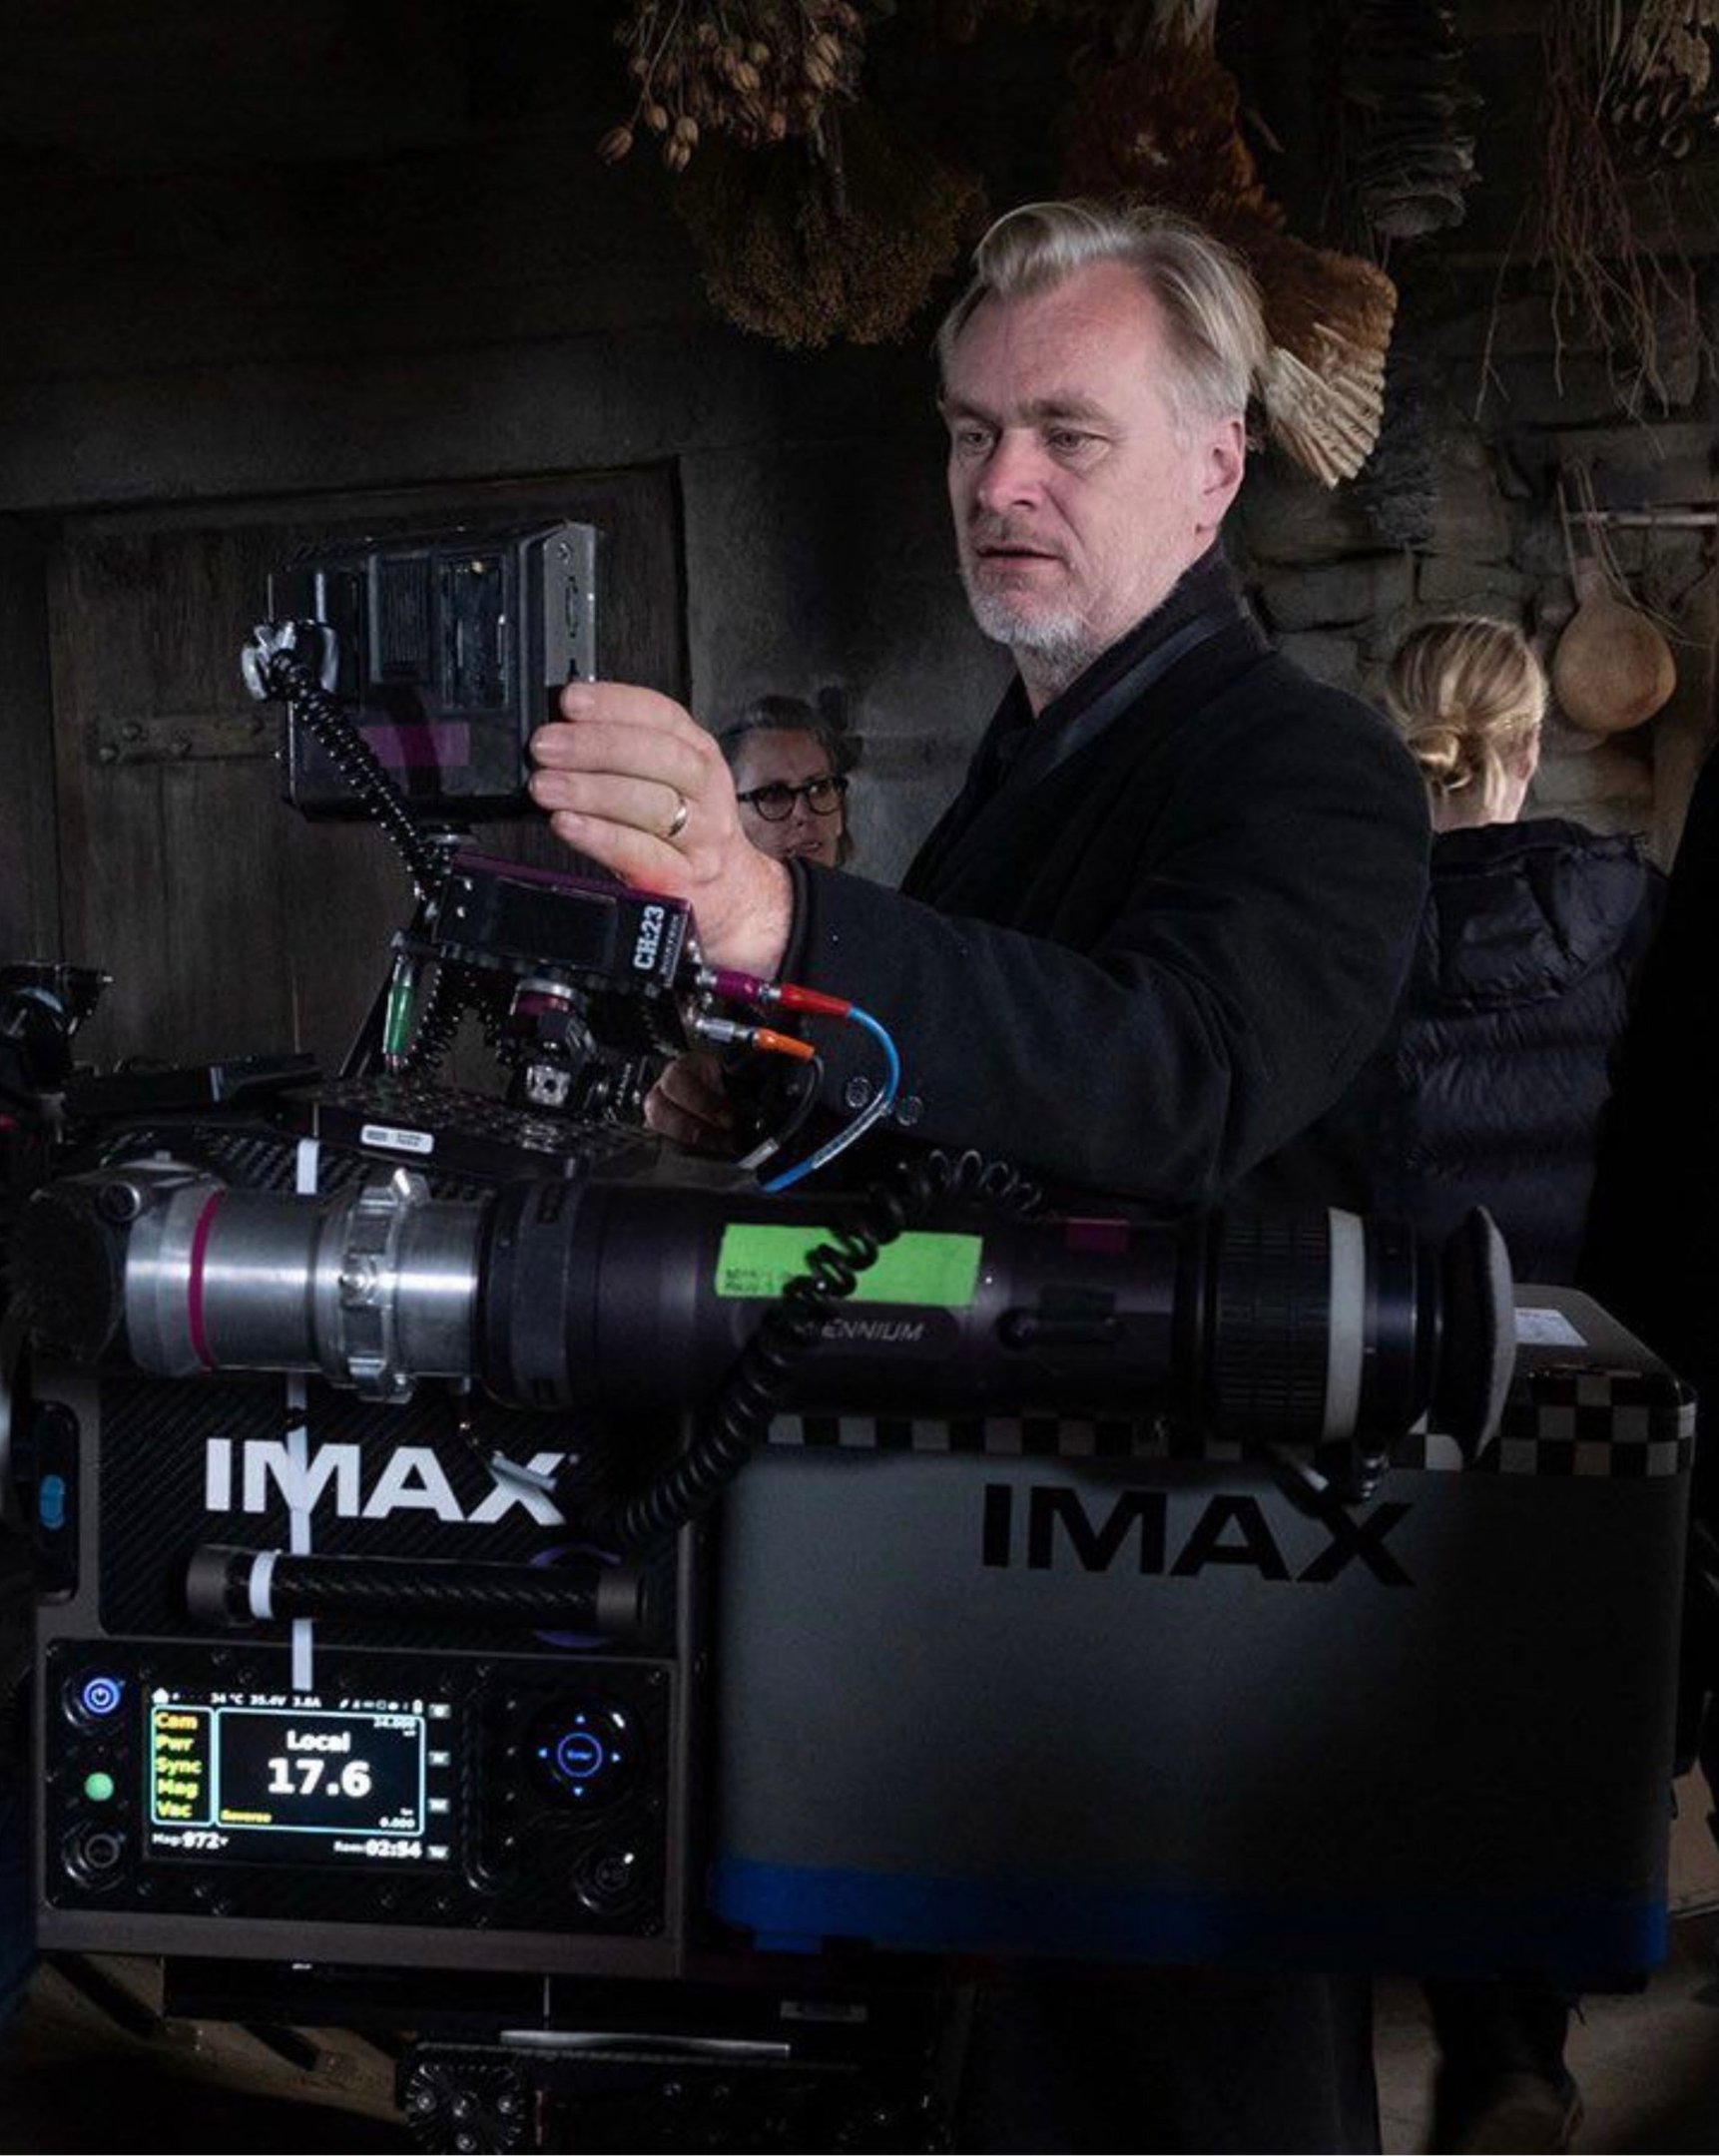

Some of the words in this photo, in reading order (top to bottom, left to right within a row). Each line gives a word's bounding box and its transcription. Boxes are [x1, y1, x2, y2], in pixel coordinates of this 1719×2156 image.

[206, 1438, 566, 1526] IMAX
[983, 1484, 1416, 1587] IMAX
[155, 1712, 199, 1730] Cam
[156, 1735, 195, 1752] Pwr
[286, 1730, 350, 1753] Local
[156, 1757, 202, 1778] Sync
[268, 1757, 372, 1798] 17.6
[158, 1779, 199, 1800] Mag
[157, 1801, 193, 1819] Vac
